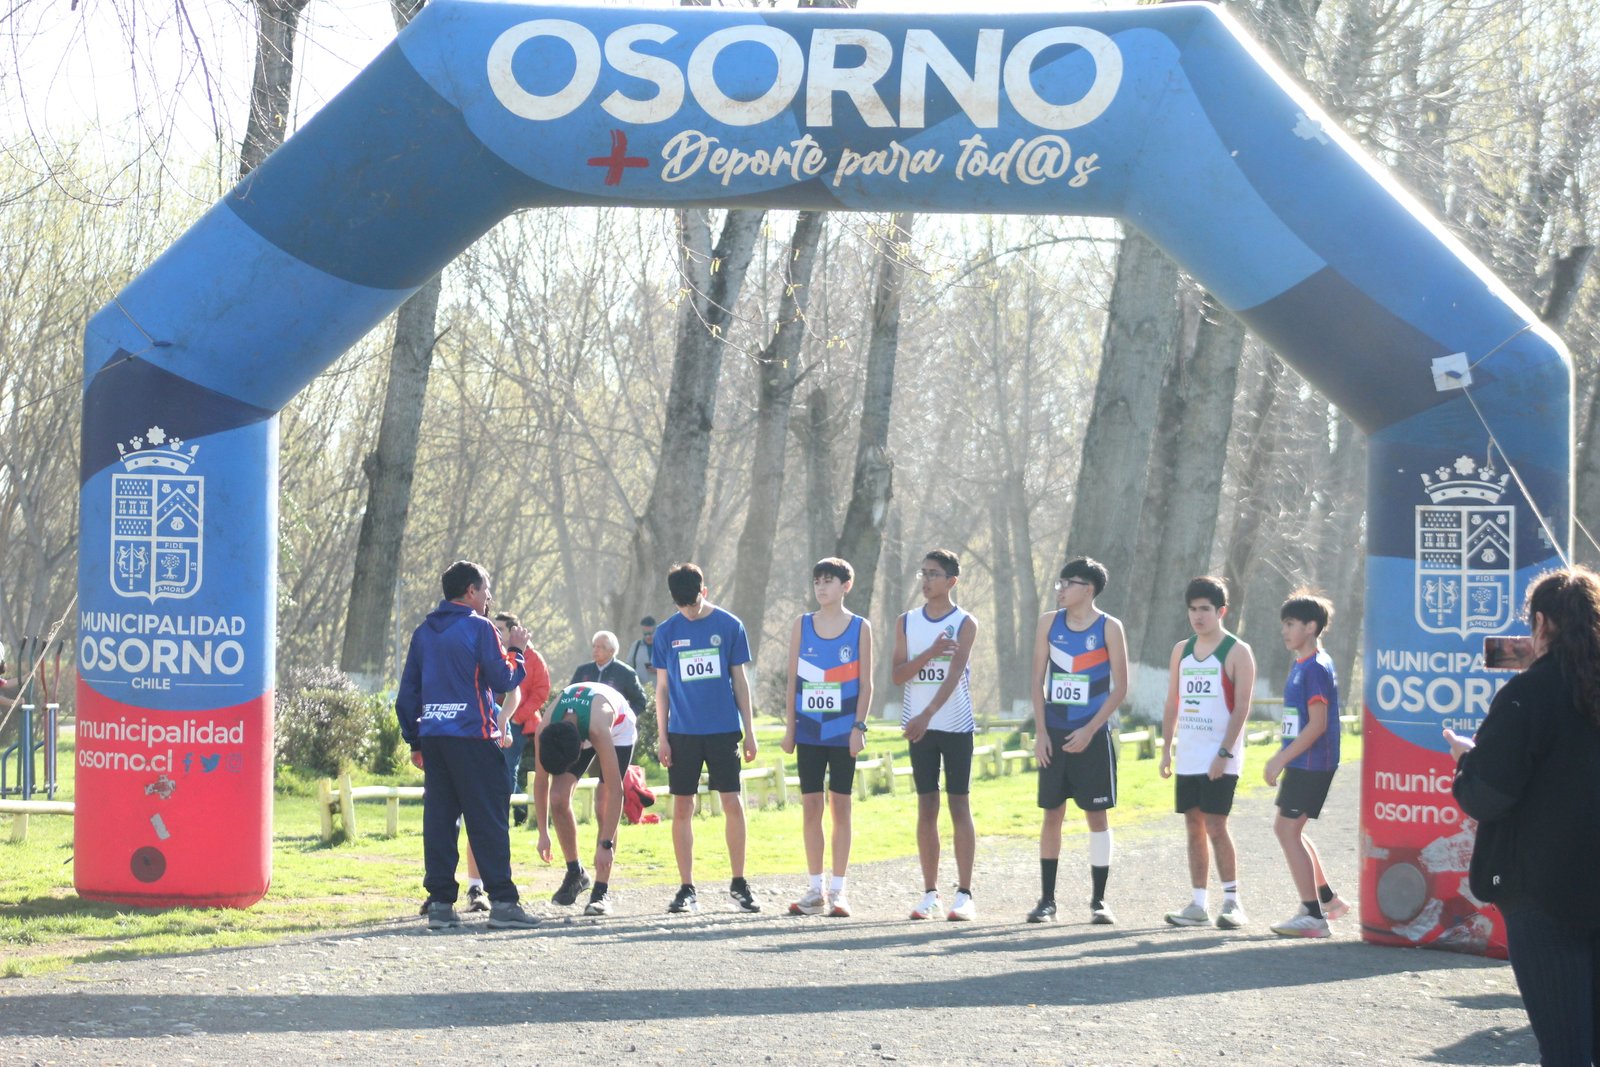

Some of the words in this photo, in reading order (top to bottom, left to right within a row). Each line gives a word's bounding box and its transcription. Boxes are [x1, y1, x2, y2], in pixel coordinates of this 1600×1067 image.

[487, 18, 1123, 130] OSORNO
[661, 129, 826, 186] Deporte
[833, 140, 944, 187] para
[955, 133, 1101, 188] tod@s
[157, 585, 186, 593] AMORE
[81, 611, 246, 636] MUNICIPALIDAD
[1469, 620, 1498, 628] AMORE
[81, 635, 244, 675] OSORNO
[1376, 649, 1518, 673] MUNICIPA
[687, 661, 714, 676] 004
[918, 668, 945, 681] 003
[131, 677, 171, 690] CHILE
[1186, 680, 1211, 693] 002
[1056, 686, 1081, 700] 005
[808, 696, 834, 709] 006
[79, 717, 244, 748] municipalidad
[79, 749, 173, 772] osorno.cl
